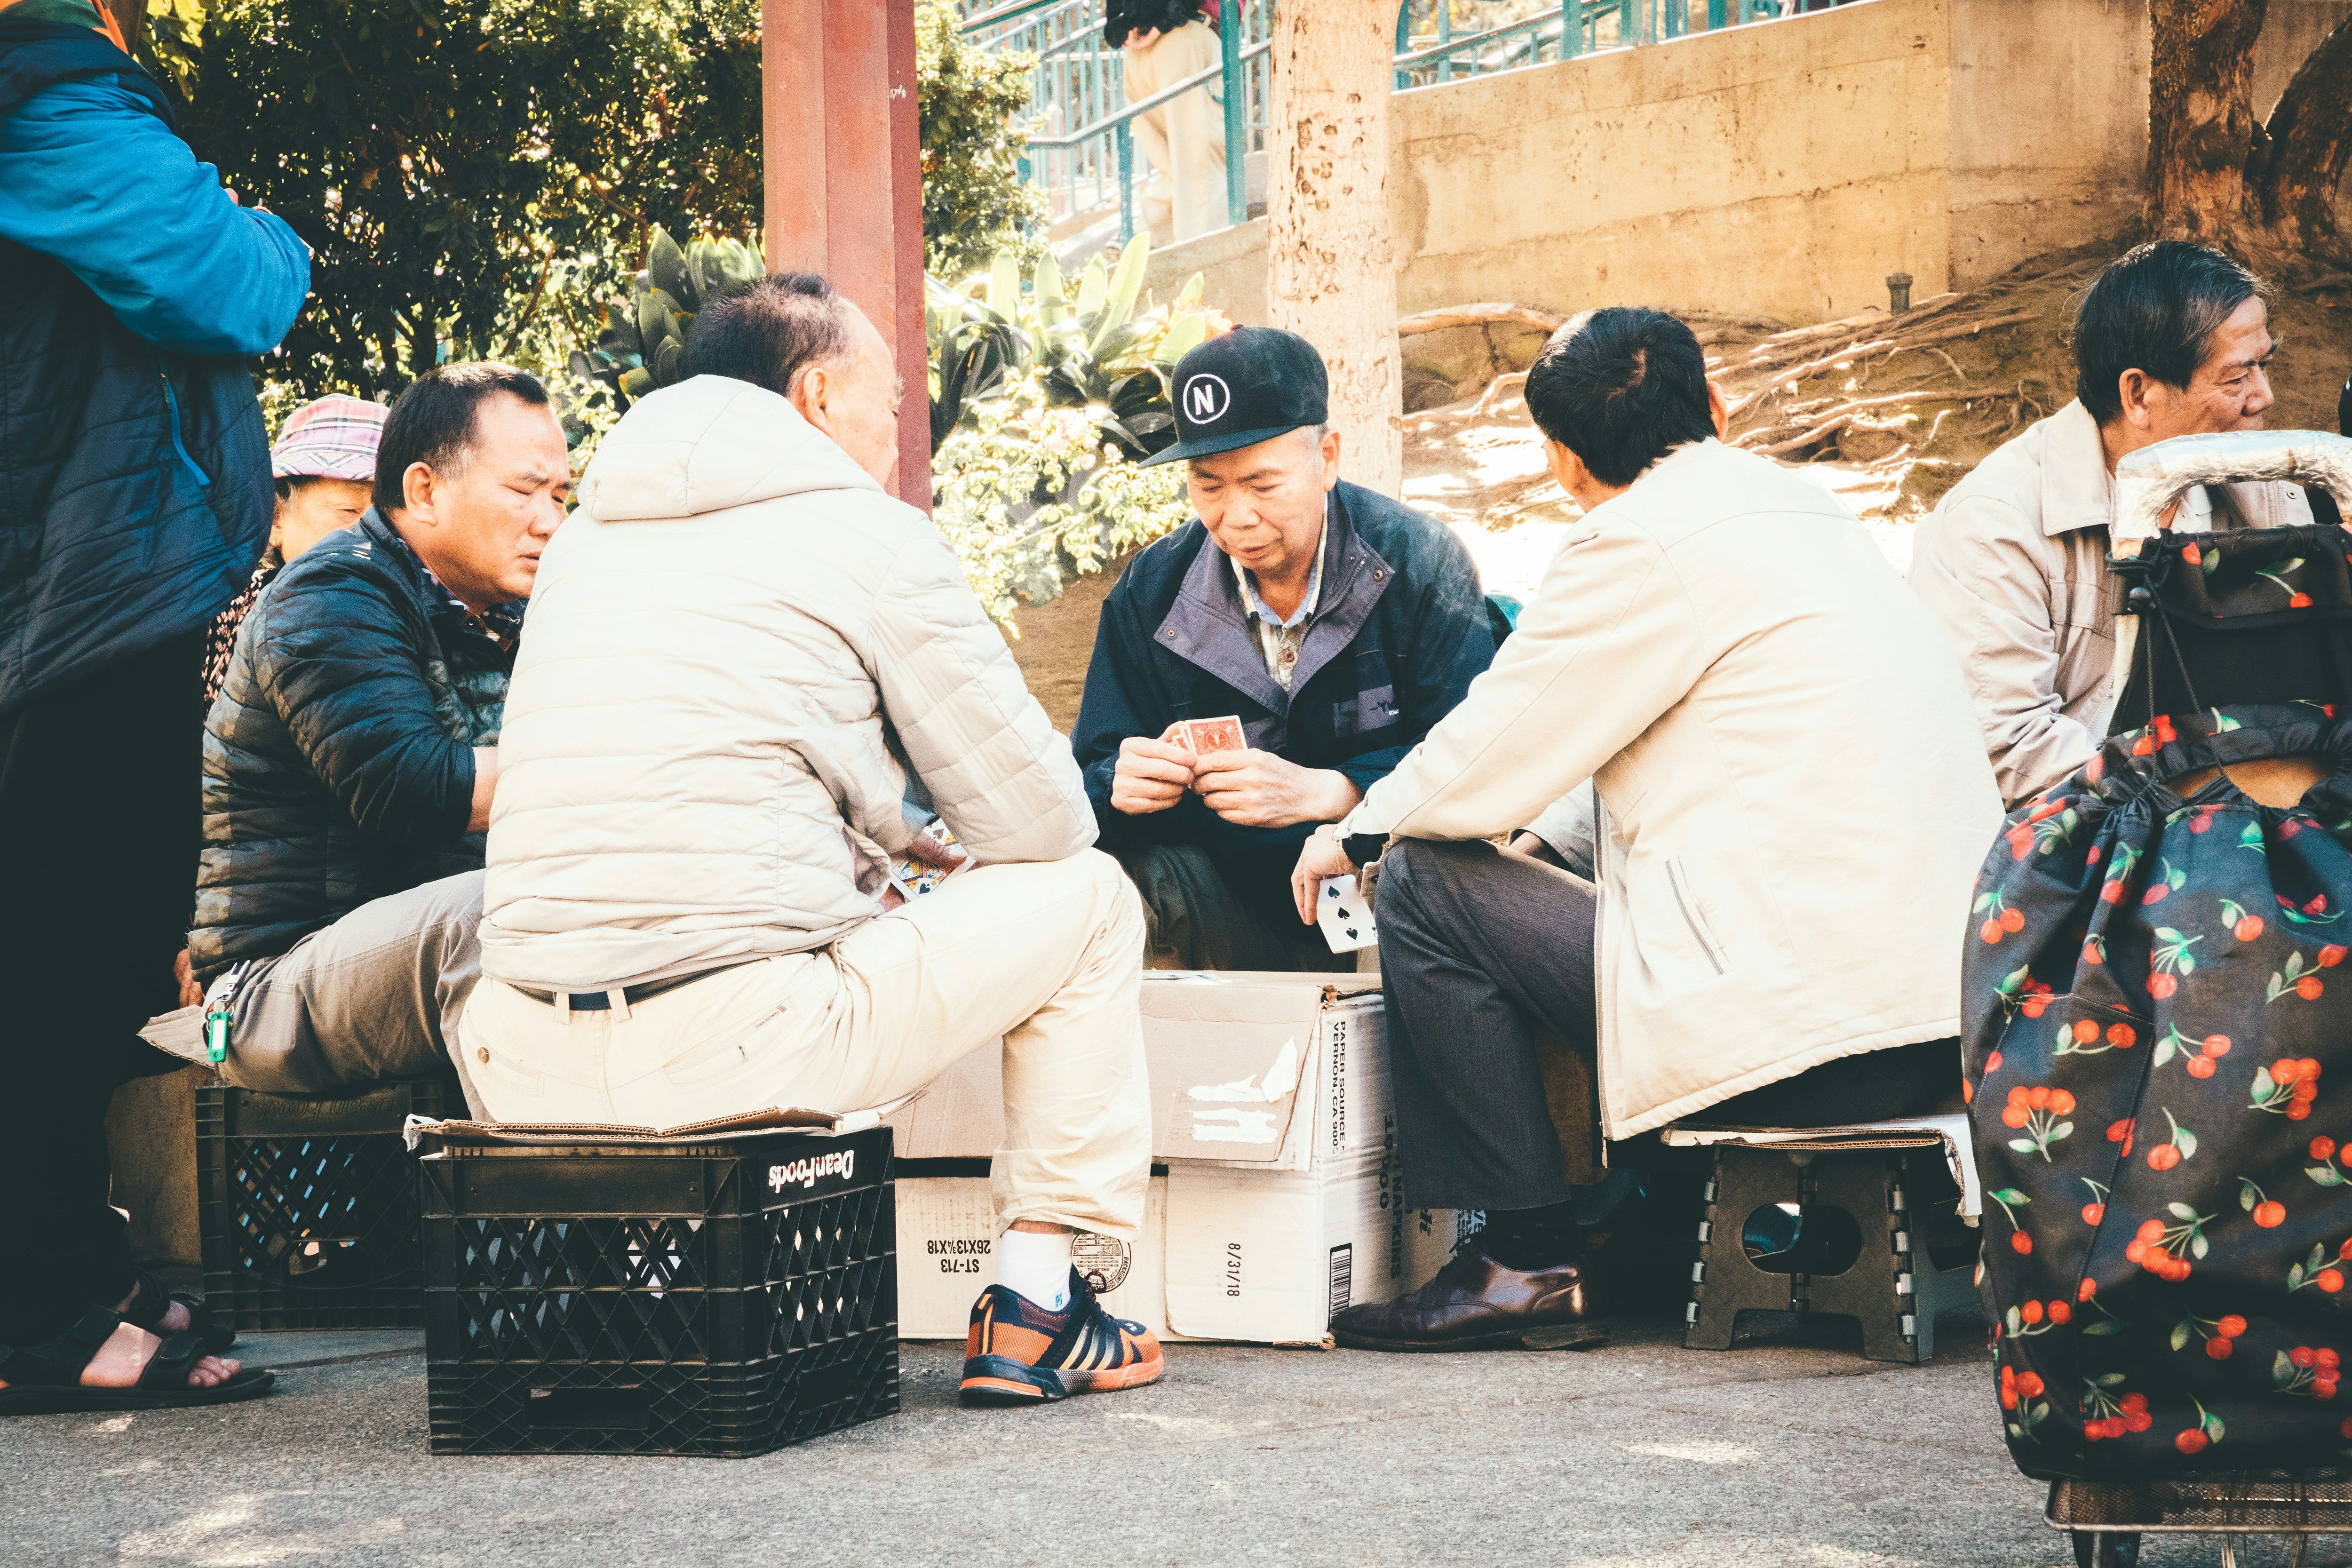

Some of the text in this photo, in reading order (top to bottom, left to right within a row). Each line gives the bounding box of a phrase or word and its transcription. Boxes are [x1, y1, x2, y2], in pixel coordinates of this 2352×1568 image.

[1193, 384, 1215, 415] N
[252, 1100, 324, 1123] Foods
[1332, 1096, 1338, 1118] CA
[1391, 1175, 1404, 1280] NAPKINS
[940, 1259, 979, 1273] ST-713
[1115, 1257, 1128, 1284] PACKAGING
[1226, 1243, 1242, 1297] 8/31/18
